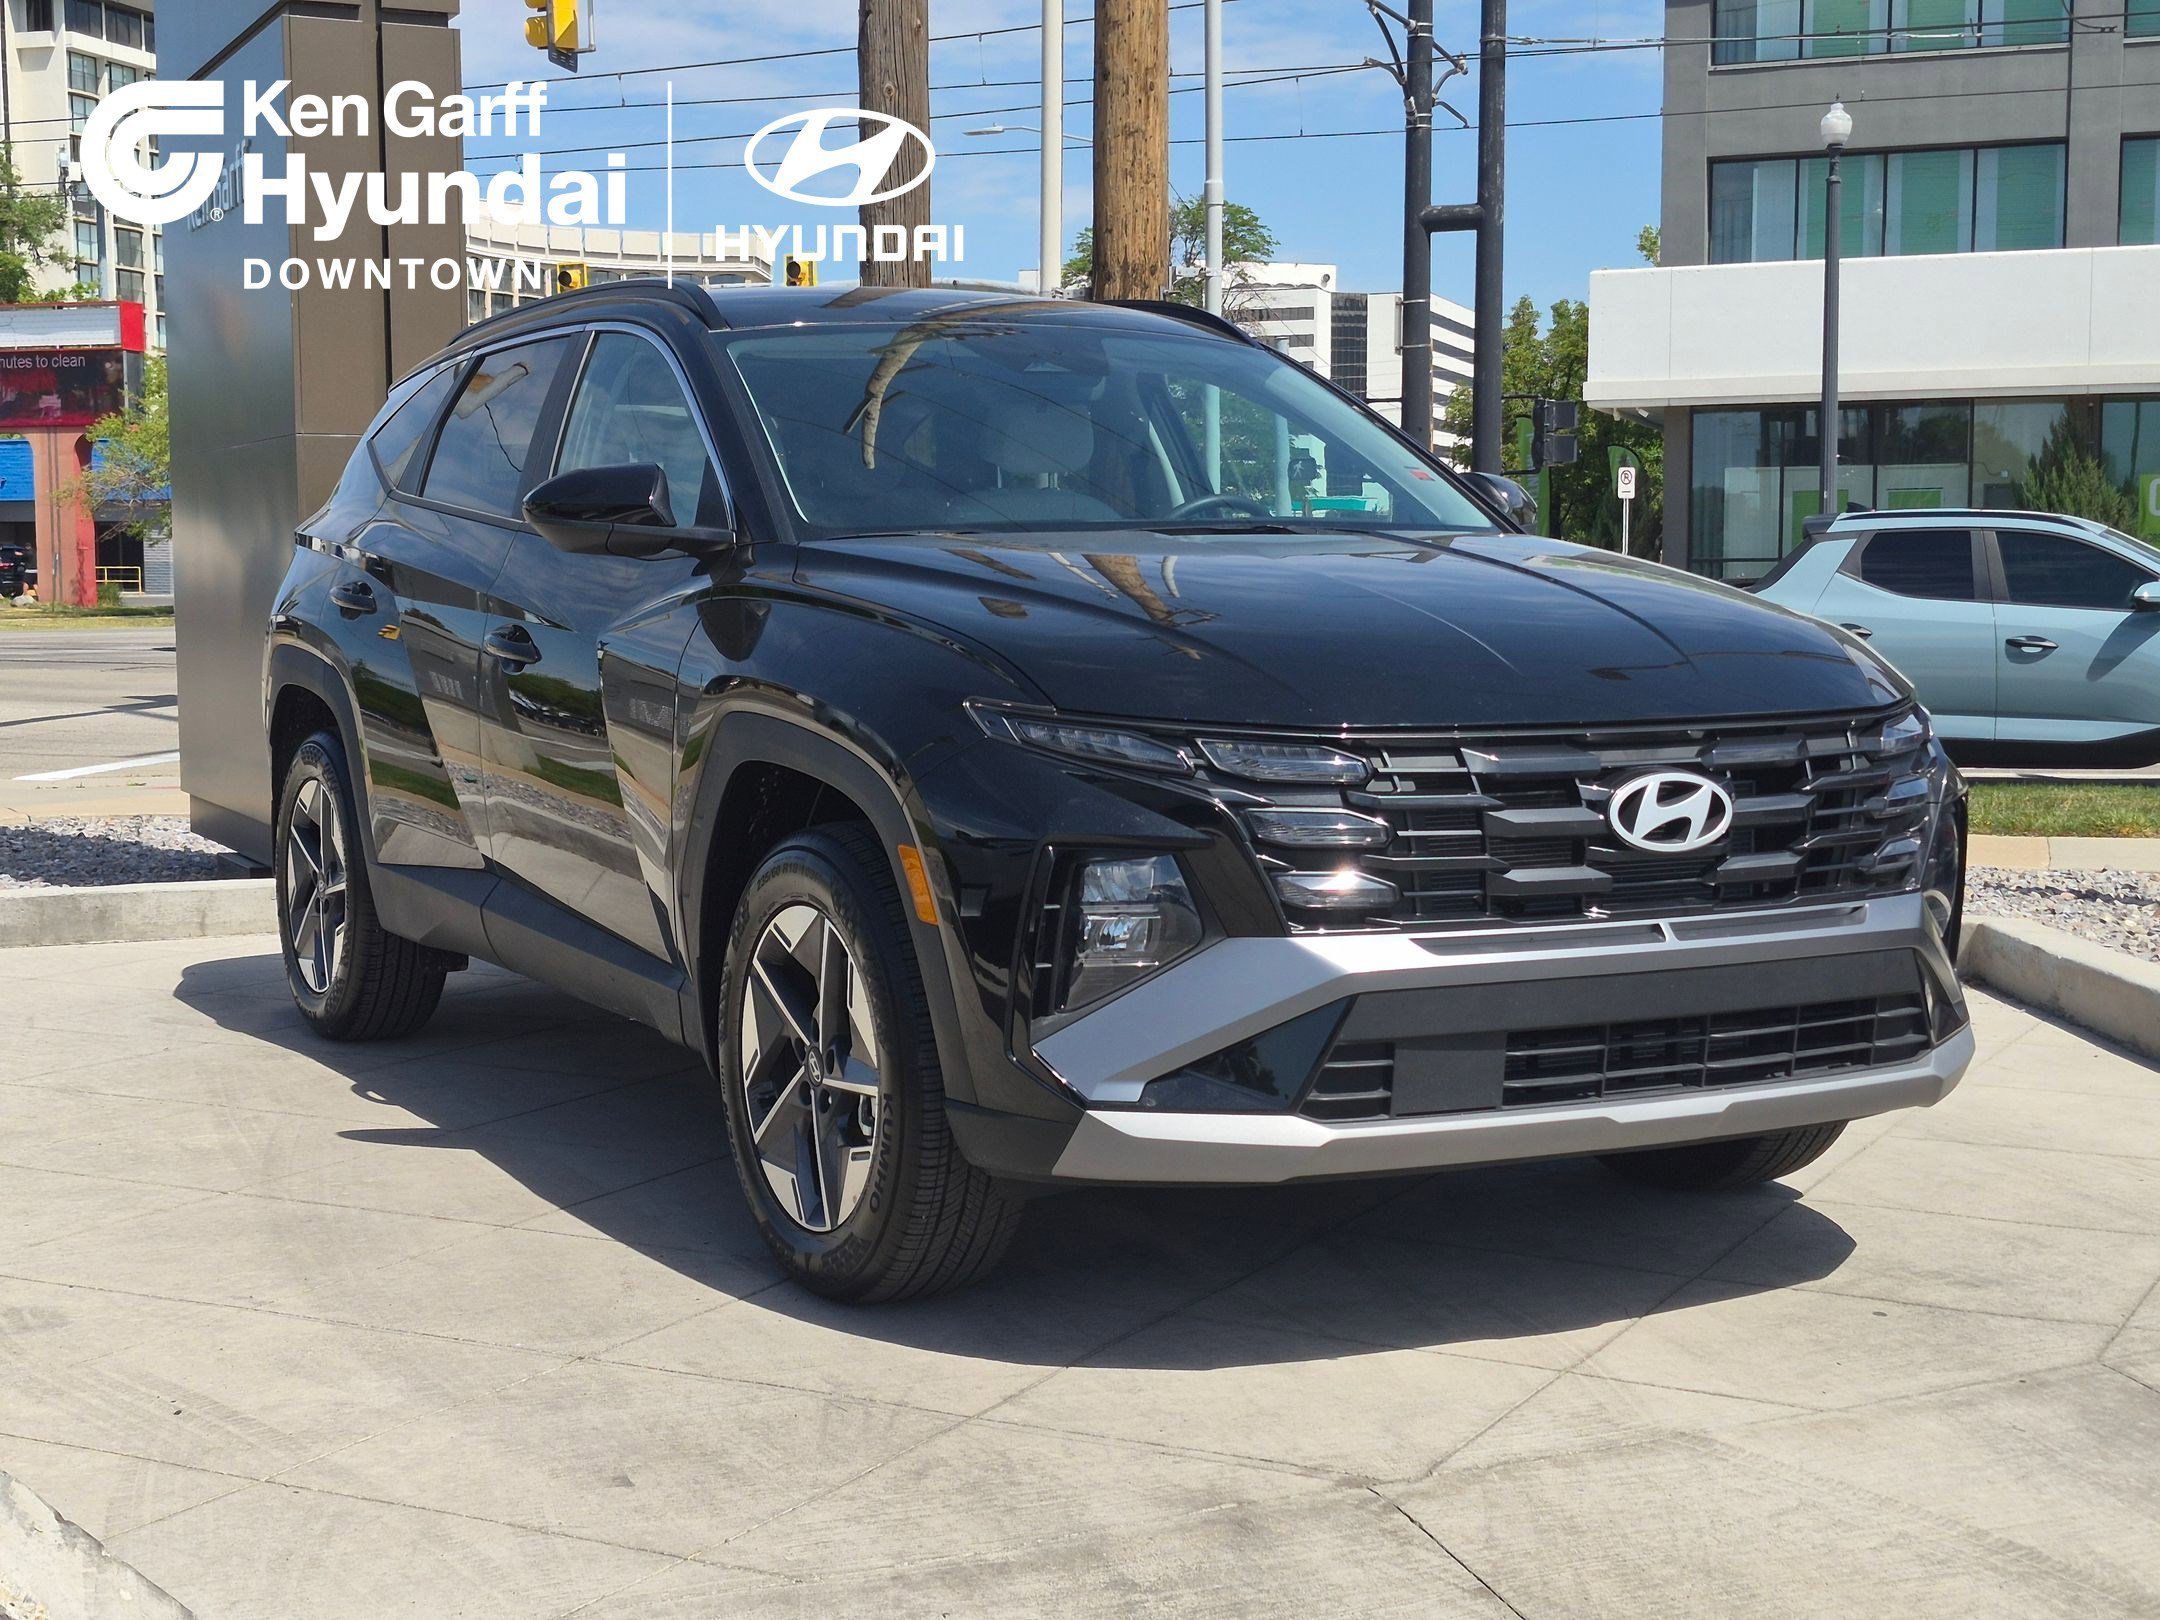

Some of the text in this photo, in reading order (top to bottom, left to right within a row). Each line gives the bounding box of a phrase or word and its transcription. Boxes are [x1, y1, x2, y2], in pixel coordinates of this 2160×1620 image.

[36, 355, 48, 368] to
[52, 354, 85, 368] clean
[869, 1093, 893, 1213] KUMHO
